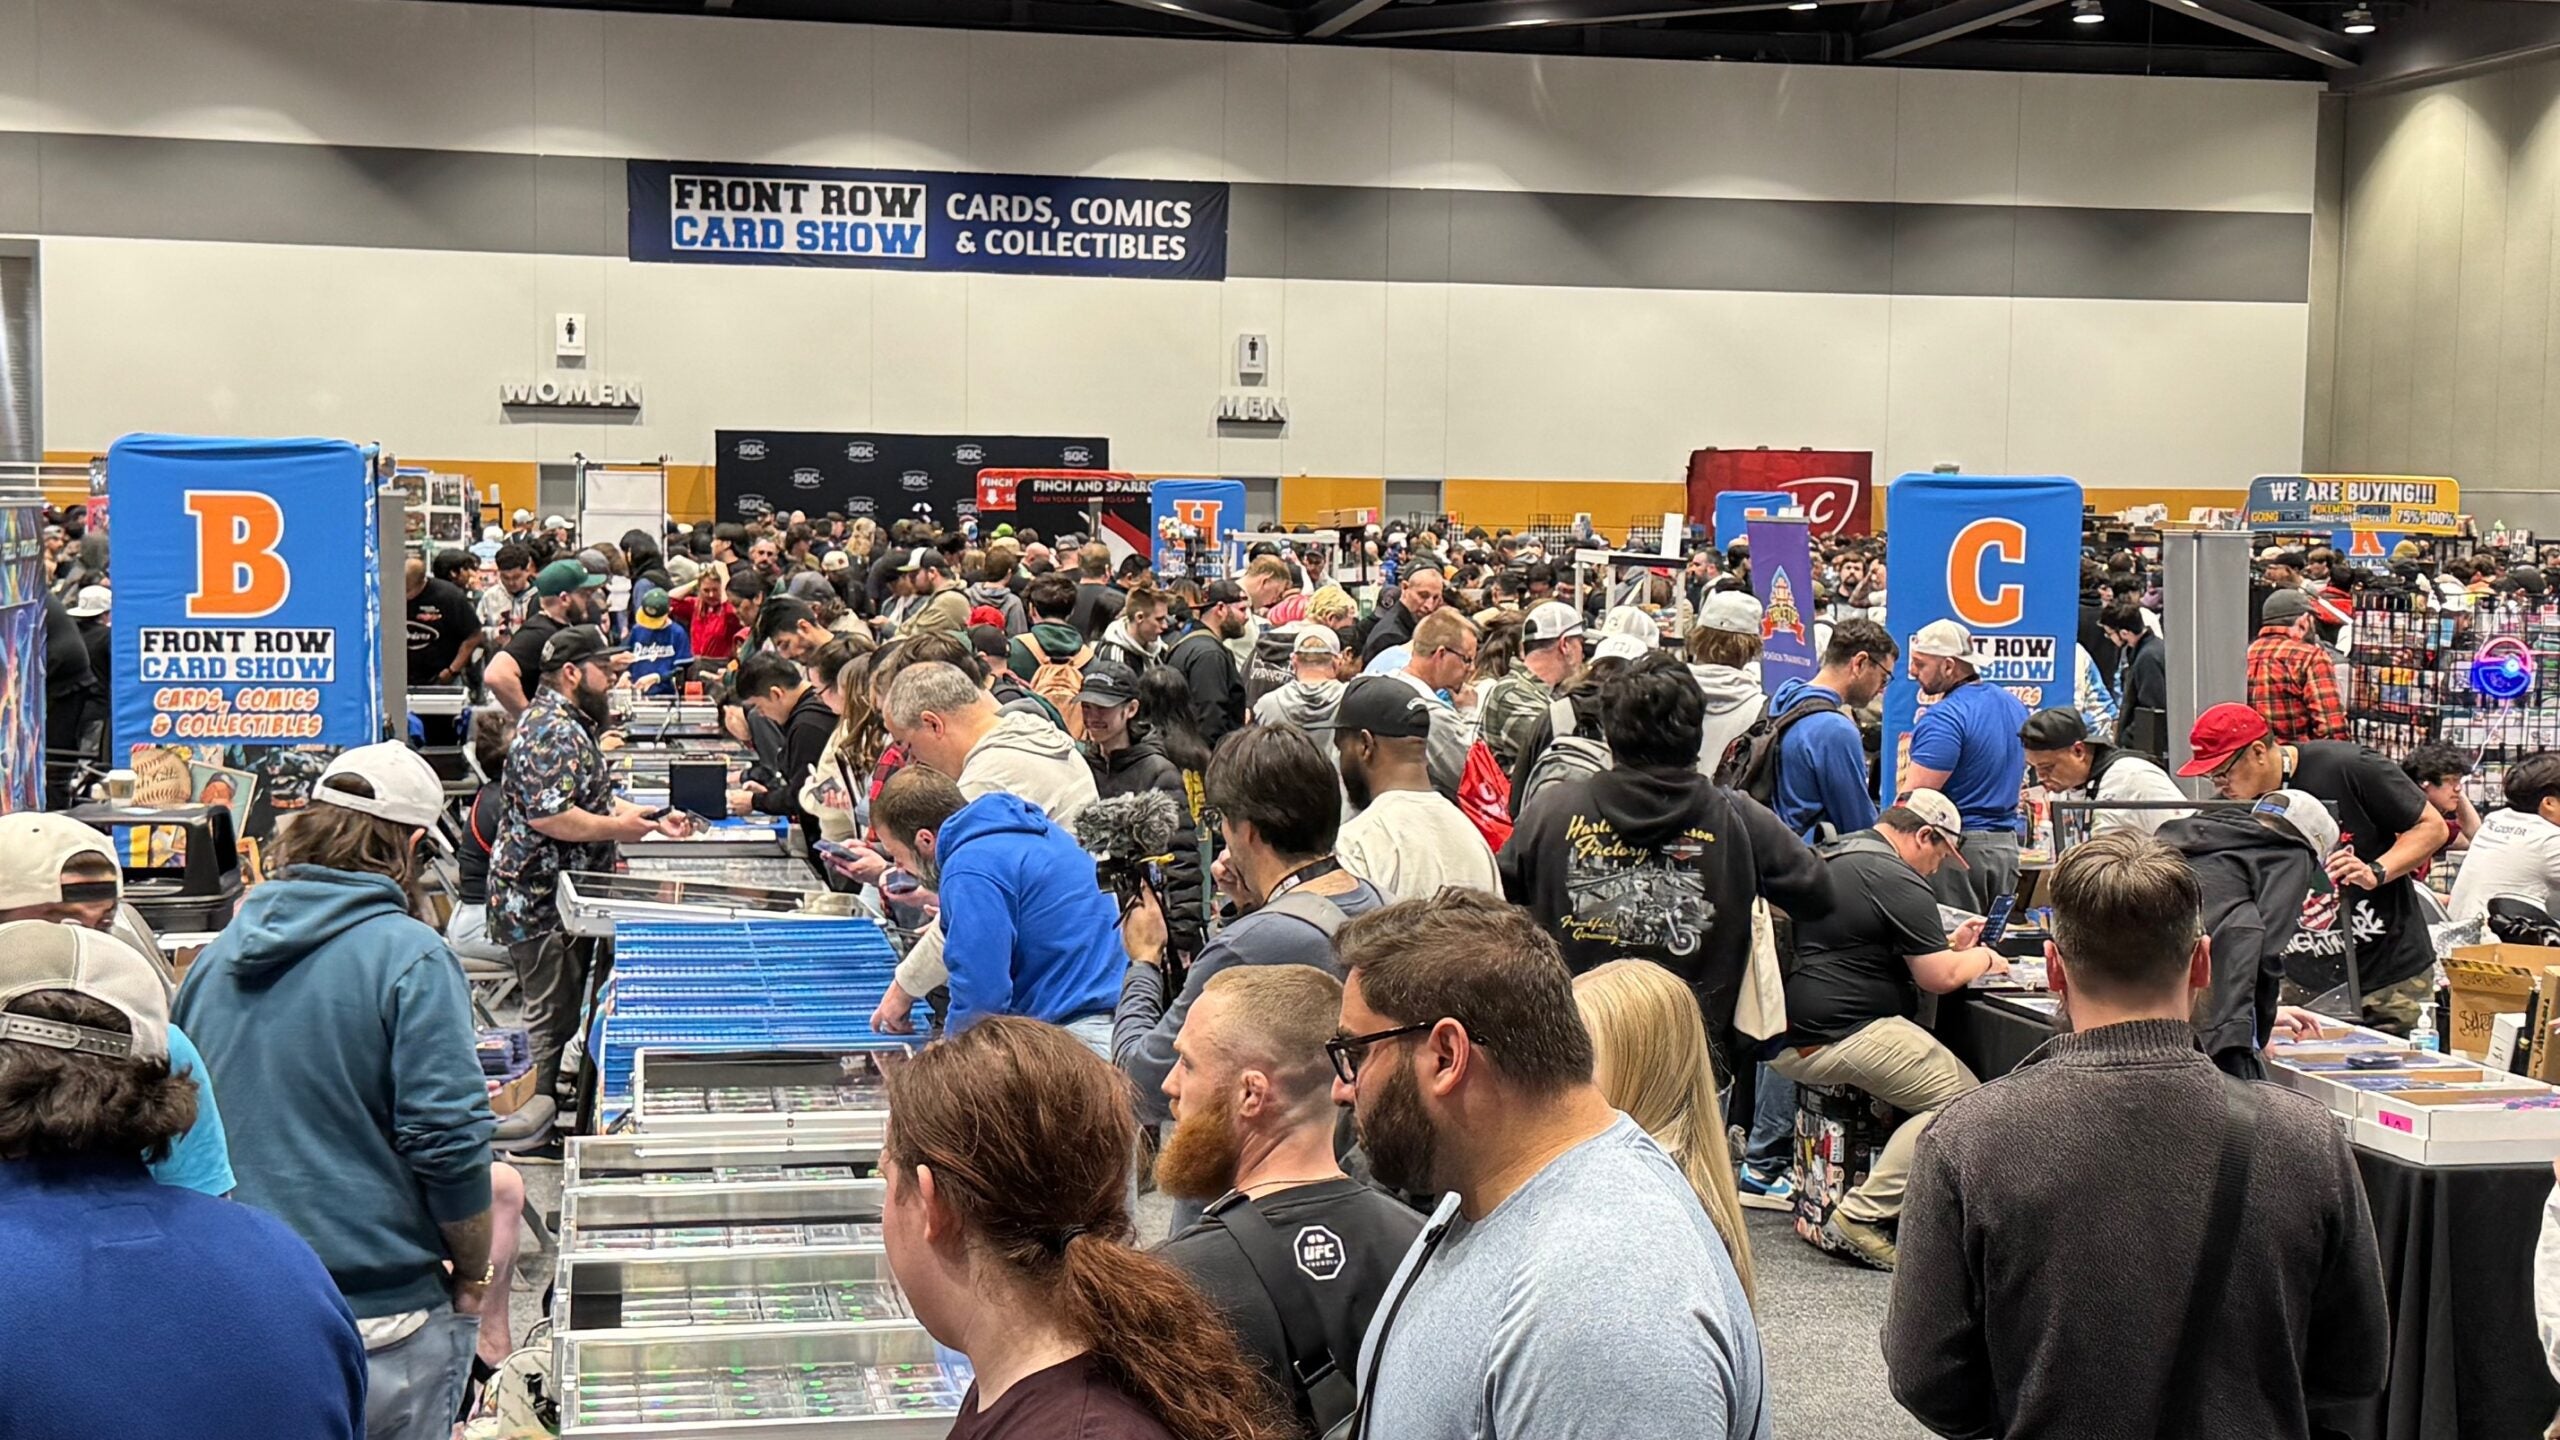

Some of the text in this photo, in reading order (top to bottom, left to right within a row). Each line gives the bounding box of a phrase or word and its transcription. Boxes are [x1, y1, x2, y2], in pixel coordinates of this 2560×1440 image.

[675, 179, 921, 218] FRONT ROW
[946, 193, 1192, 229] CARDS, COMICS
[674, 215, 922, 254] CARD SHOW
[955, 229, 1187, 261] & COLLECTIBLES
[501, 380, 642, 406] WOMEN
[1218, 396, 1286, 420] MEN
[981, 478, 1014, 487] FINCH
[1033, 480, 1072, 492] FINCH
[1074, 480, 1104, 493] AND
[2271, 482, 2436, 504] WE ARE BUYING!!!
[1173, 500, 1222, 551] H
[2251, 511, 2279, 523] GOING
[184, 490, 290, 619] B
[1946, 518, 2027, 628] C
[143, 631, 331, 653] FRONT ROW
[1994, 639, 2053, 657] ROW
[143, 657, 332, 679] CARD SHOW
[1979, 660, 2053, 679] SHOW
[154, 687, 320, 714] CARDS, COMICS
[151, 713, 323, 739] & COLLECTIBLES
[1575, 834, 1649, 866] Factory
[1304, 1243, 1335, 1260] UFC
